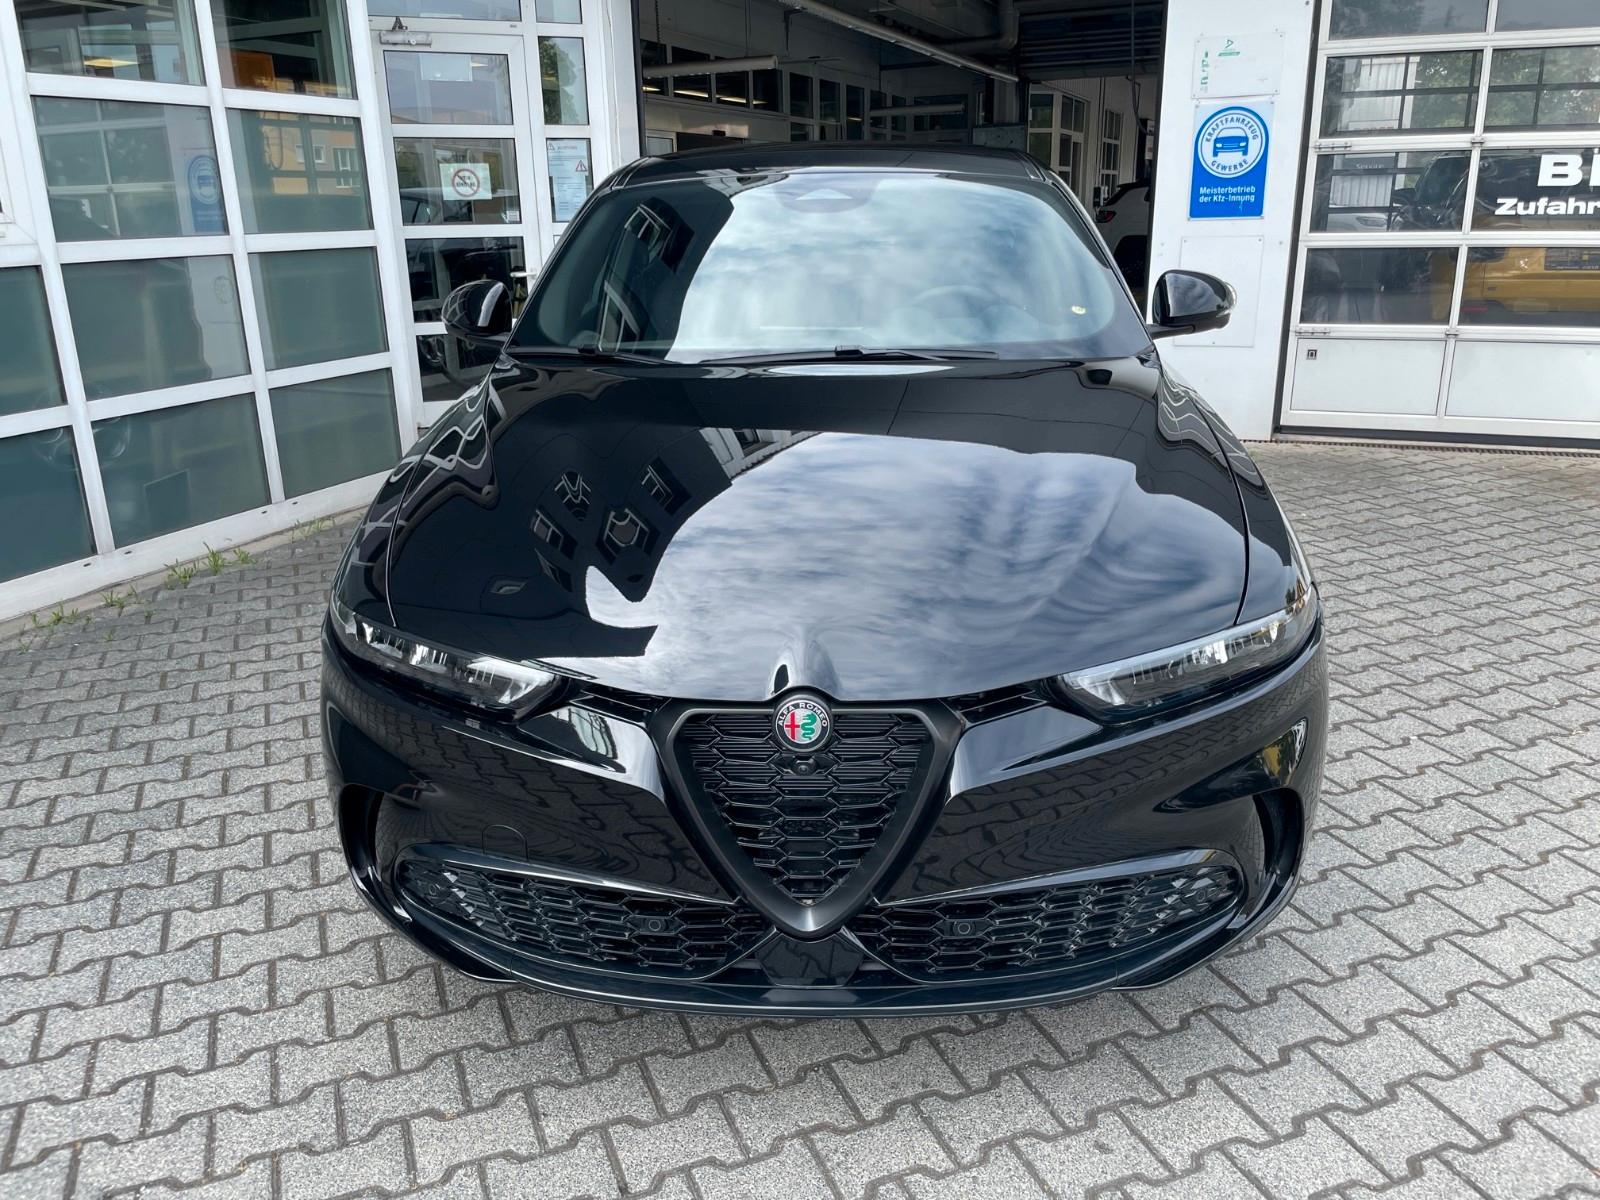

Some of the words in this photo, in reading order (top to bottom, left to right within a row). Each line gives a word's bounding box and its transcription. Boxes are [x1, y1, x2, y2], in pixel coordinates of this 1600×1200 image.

[1205, 116, 1259, 142] KRAFTFAHRZEUG
[1211, 158, 1249, 172] GEWERBE
[1199, 186, 1256, 195] Meisterbetrieb
[1199, 194, 1212, 203] der
[1213, 194, 1255, 203] Kfz-Innung
[1494, 197, 1600, 215] Zufahr
[778, 705, 795, 727] ALFA
[799, 702, 828, 727] ROMEO
